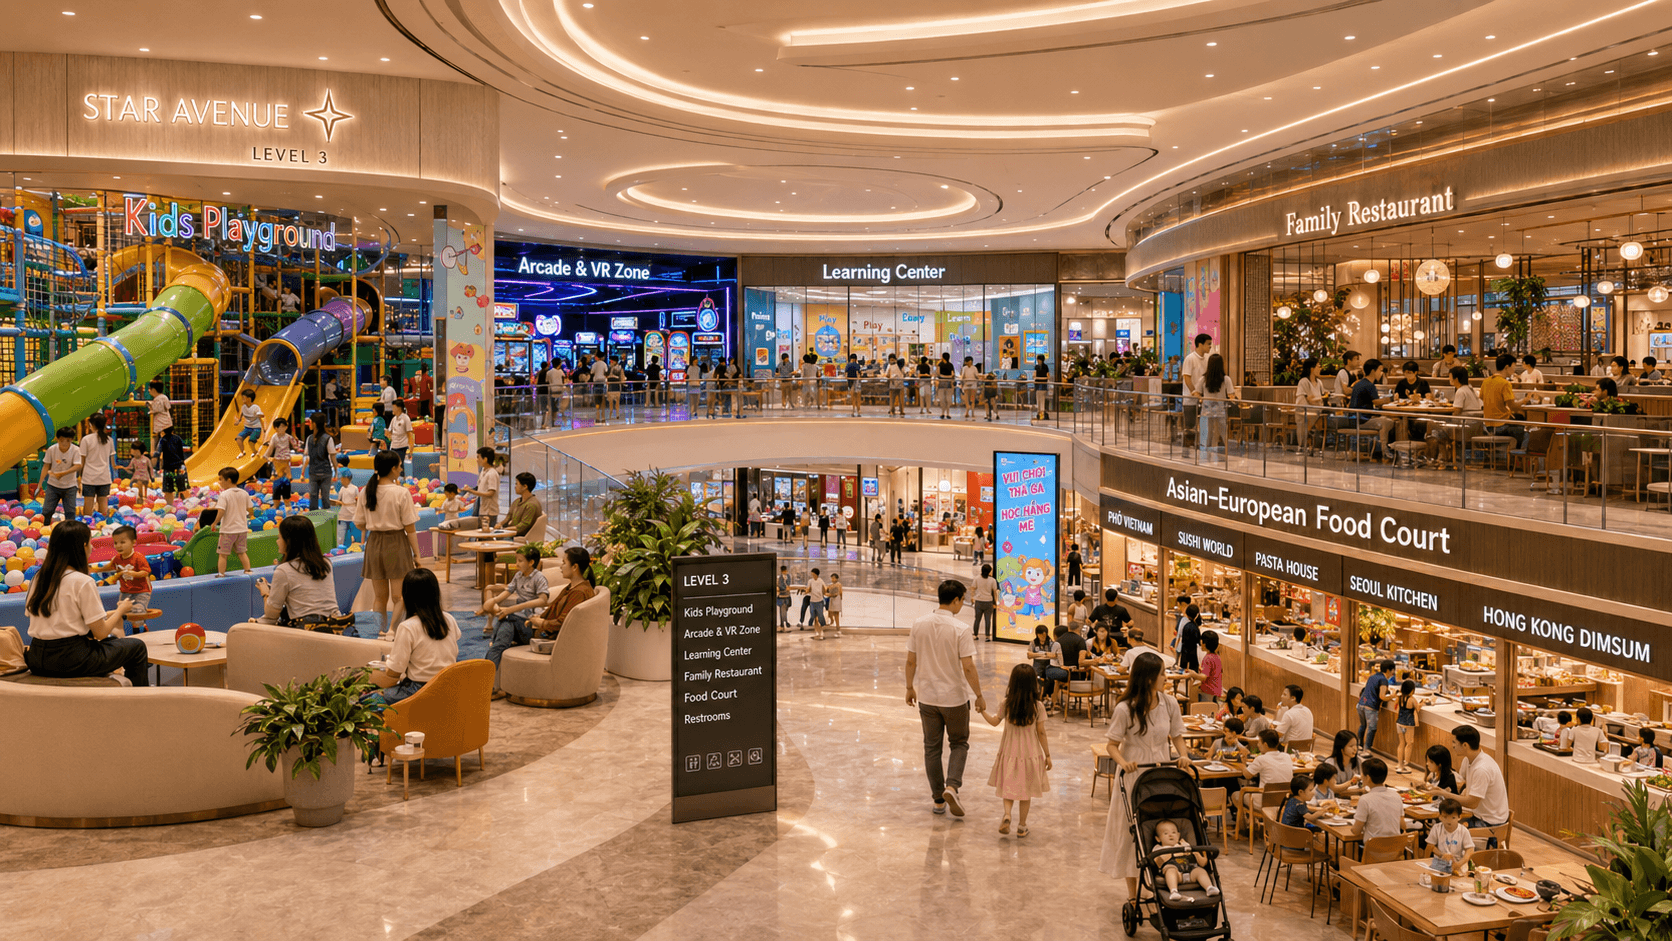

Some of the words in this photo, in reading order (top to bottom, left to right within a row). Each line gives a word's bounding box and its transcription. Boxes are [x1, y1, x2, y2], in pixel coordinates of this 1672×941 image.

[83, 93, 161, 123] STAR
[171, 98, 289, 129] AVENUE
[252, 146, 309, 163] LEVEL
[318, 151, 328, 164] 3
[1286, 205, 1342, 235] Family
[1347, 186, 1454, 226] Restaurant
[124, 197, 195, 238] Kids
[203, 205, 336, 252] Playground
[518, 256, 572, 276] Arcade
[575, 260, 588, 277] &
[591, 261, 611, 278] VR
[614, 262, 650, 280] Zone
[823, 263, 891, 283] Learning
[895, 263, 946, 280] Center
[1123, 515, 1153, 535] VIETNAM
[1316, 504, 1372, 540] Food
[1380, 516, 1450, 554] Court
[1178, 531, 1201, 549] SUSHI
[1202, 538, 1234, 558] WORLD
[1255, 551, 1284, 573] PASTA
[1286, 559, 1319, 581] HOUSE
[683, 574, 719, 587] LEVEL
[722, 573, 730, 585] 3
[1350, 575, 1383, 598] SEOUL
[1386, 584, 1438, 611] KITCHEN
[684, 607, 703, 618] Kids
[705, 603, 754, 618] Playground
[683, 628, 714, 639] Arcade
[716, 626, 723, 637] &
[725, 625, 738, 636] VR
[739, 625, 761, 635] Zone
[1483, 605, 1526, 632] HONG
[1531, 617, 1574, 644] KONG
[1579, 628, 1650, 663] DIMSUM
[684, 648, 721, 660] Learning
[723, 646, 753, 657] Center
[684, 670, 713, 682] Family
[714, 665, 763, 679] Restaurant
[684, 691, 708, 703] Food
[710, 689, 738, 700] Court
[684, 711, 731, 724] Restrooms
